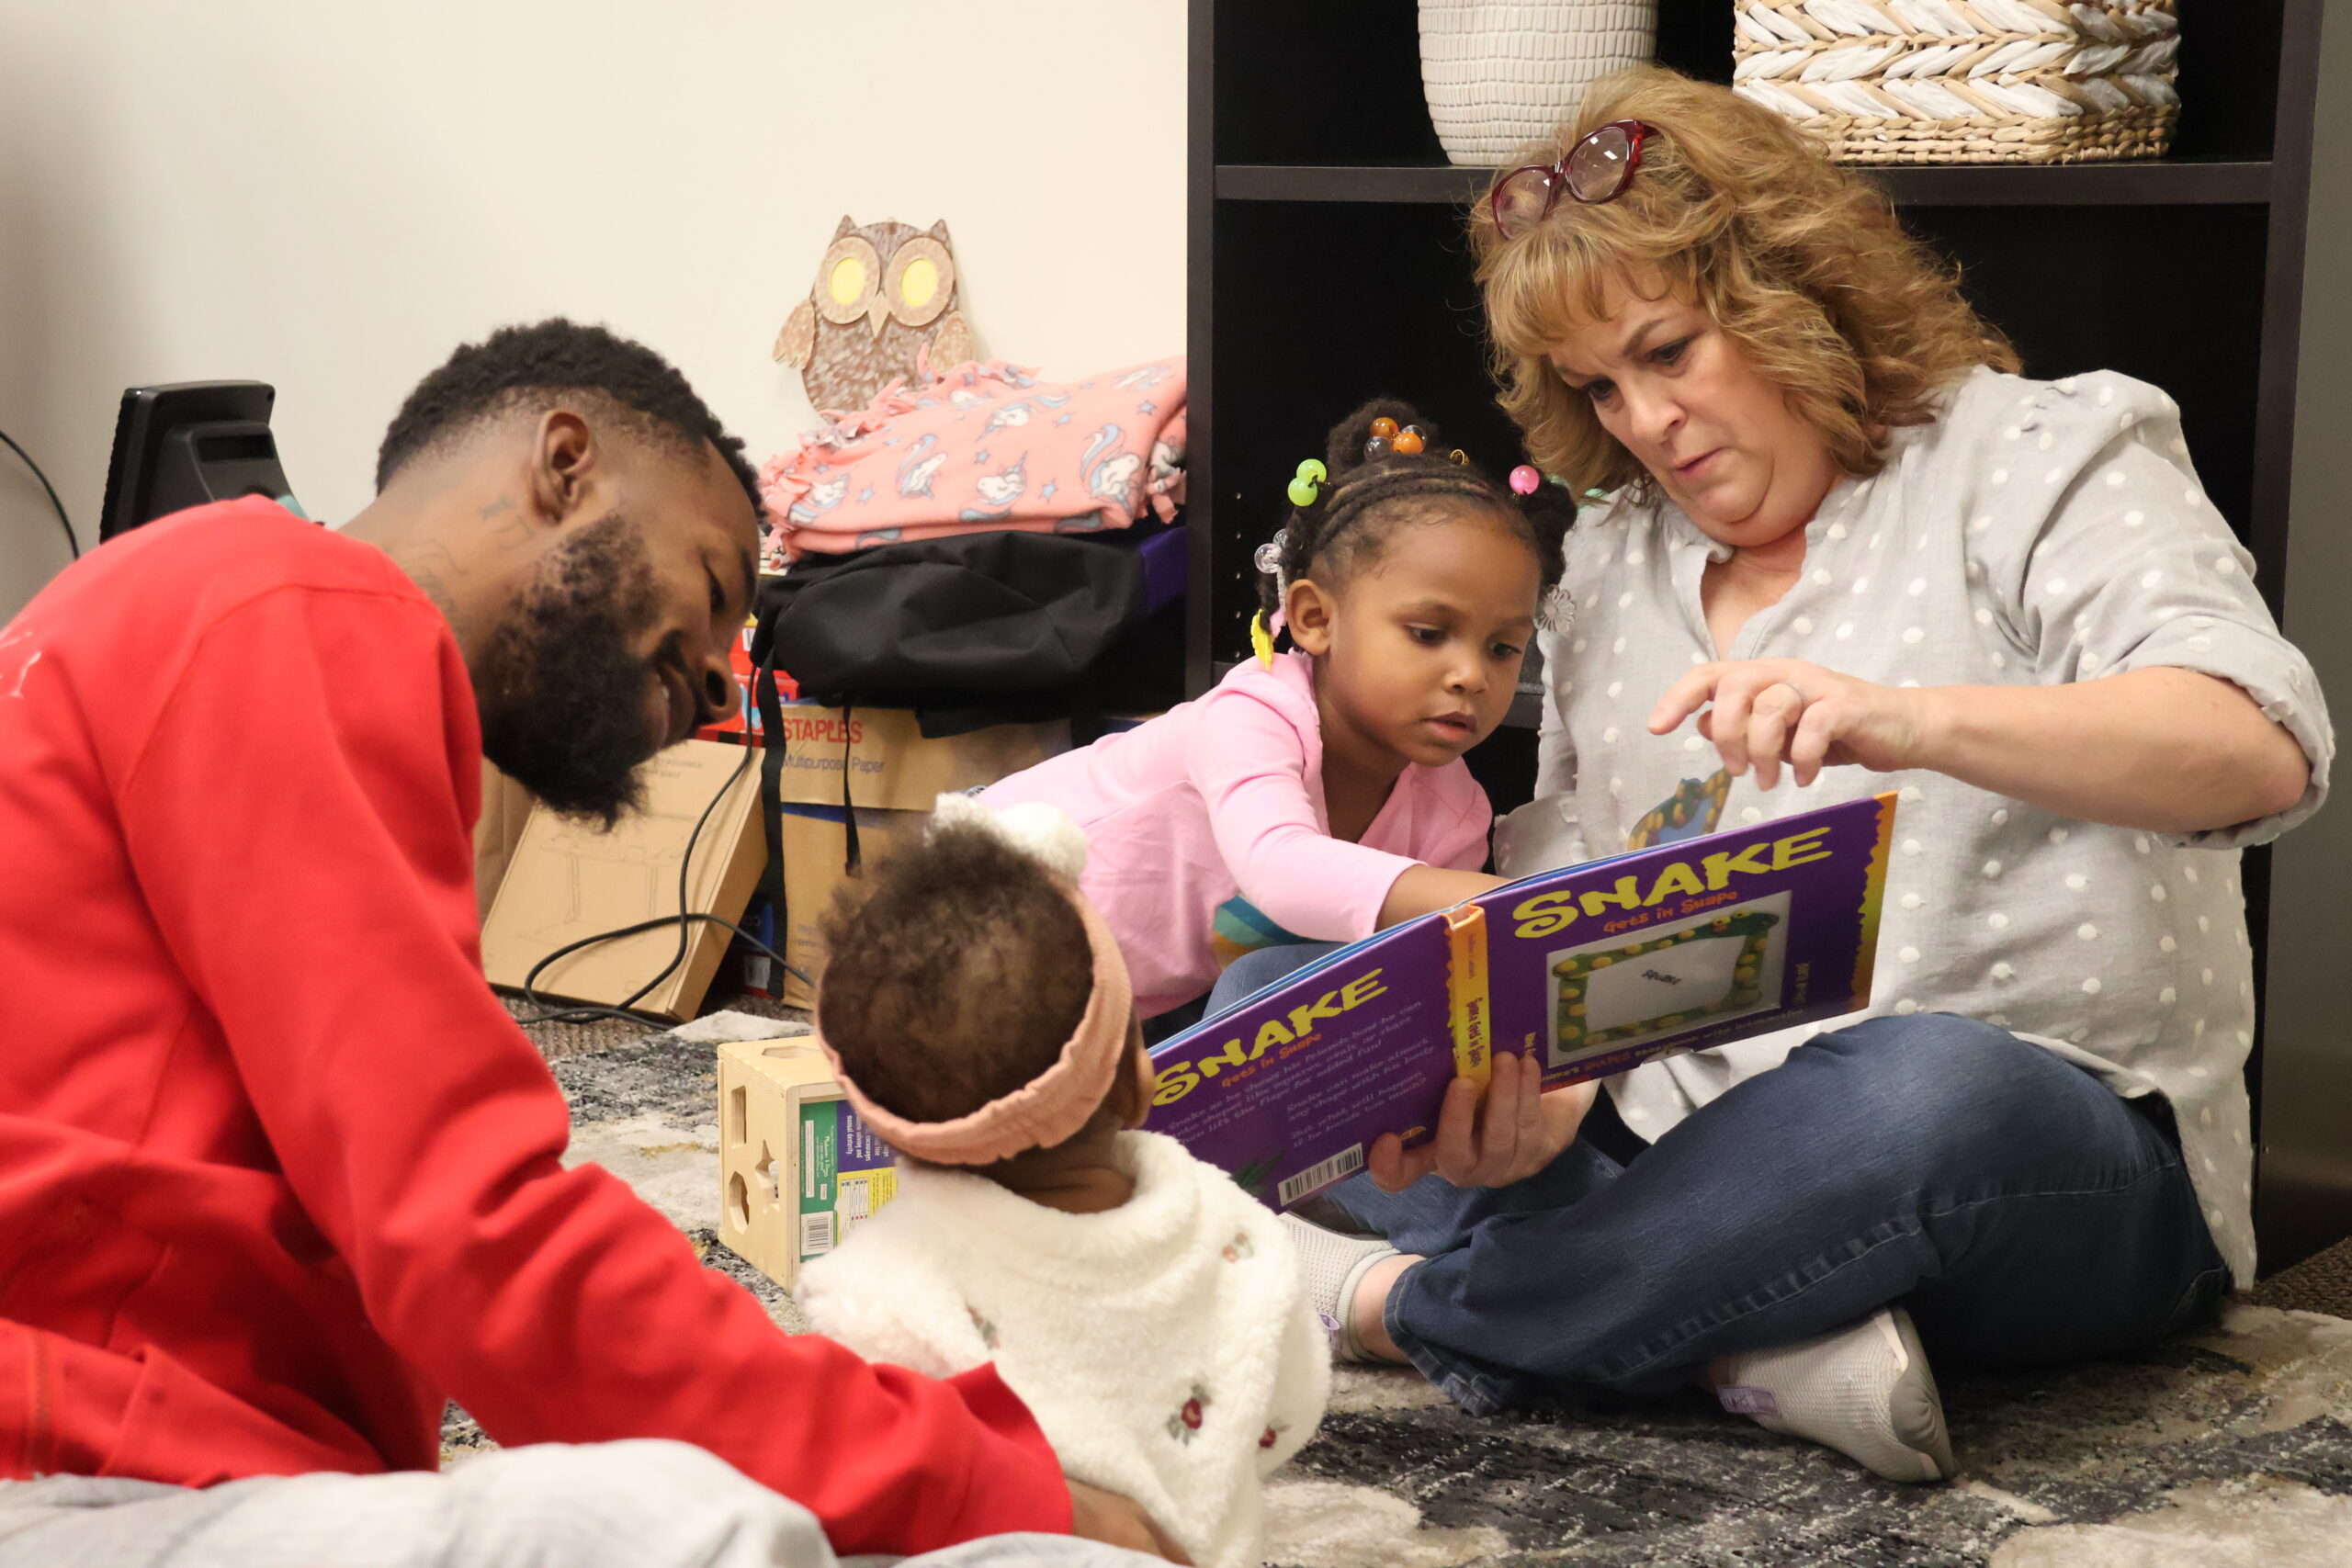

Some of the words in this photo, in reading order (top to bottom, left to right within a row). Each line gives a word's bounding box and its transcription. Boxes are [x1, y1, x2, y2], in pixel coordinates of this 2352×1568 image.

[782, 718, 863, 744] STAPLES
[852, 756, 886, 773] Paper
[1512, 827, 1833, 939] SNAKE
[1603, 913, 1649, 933] Gets
[1681, 891, 1738, 913] Shape
[1152, 967, 1388, 1106] SNAKE
